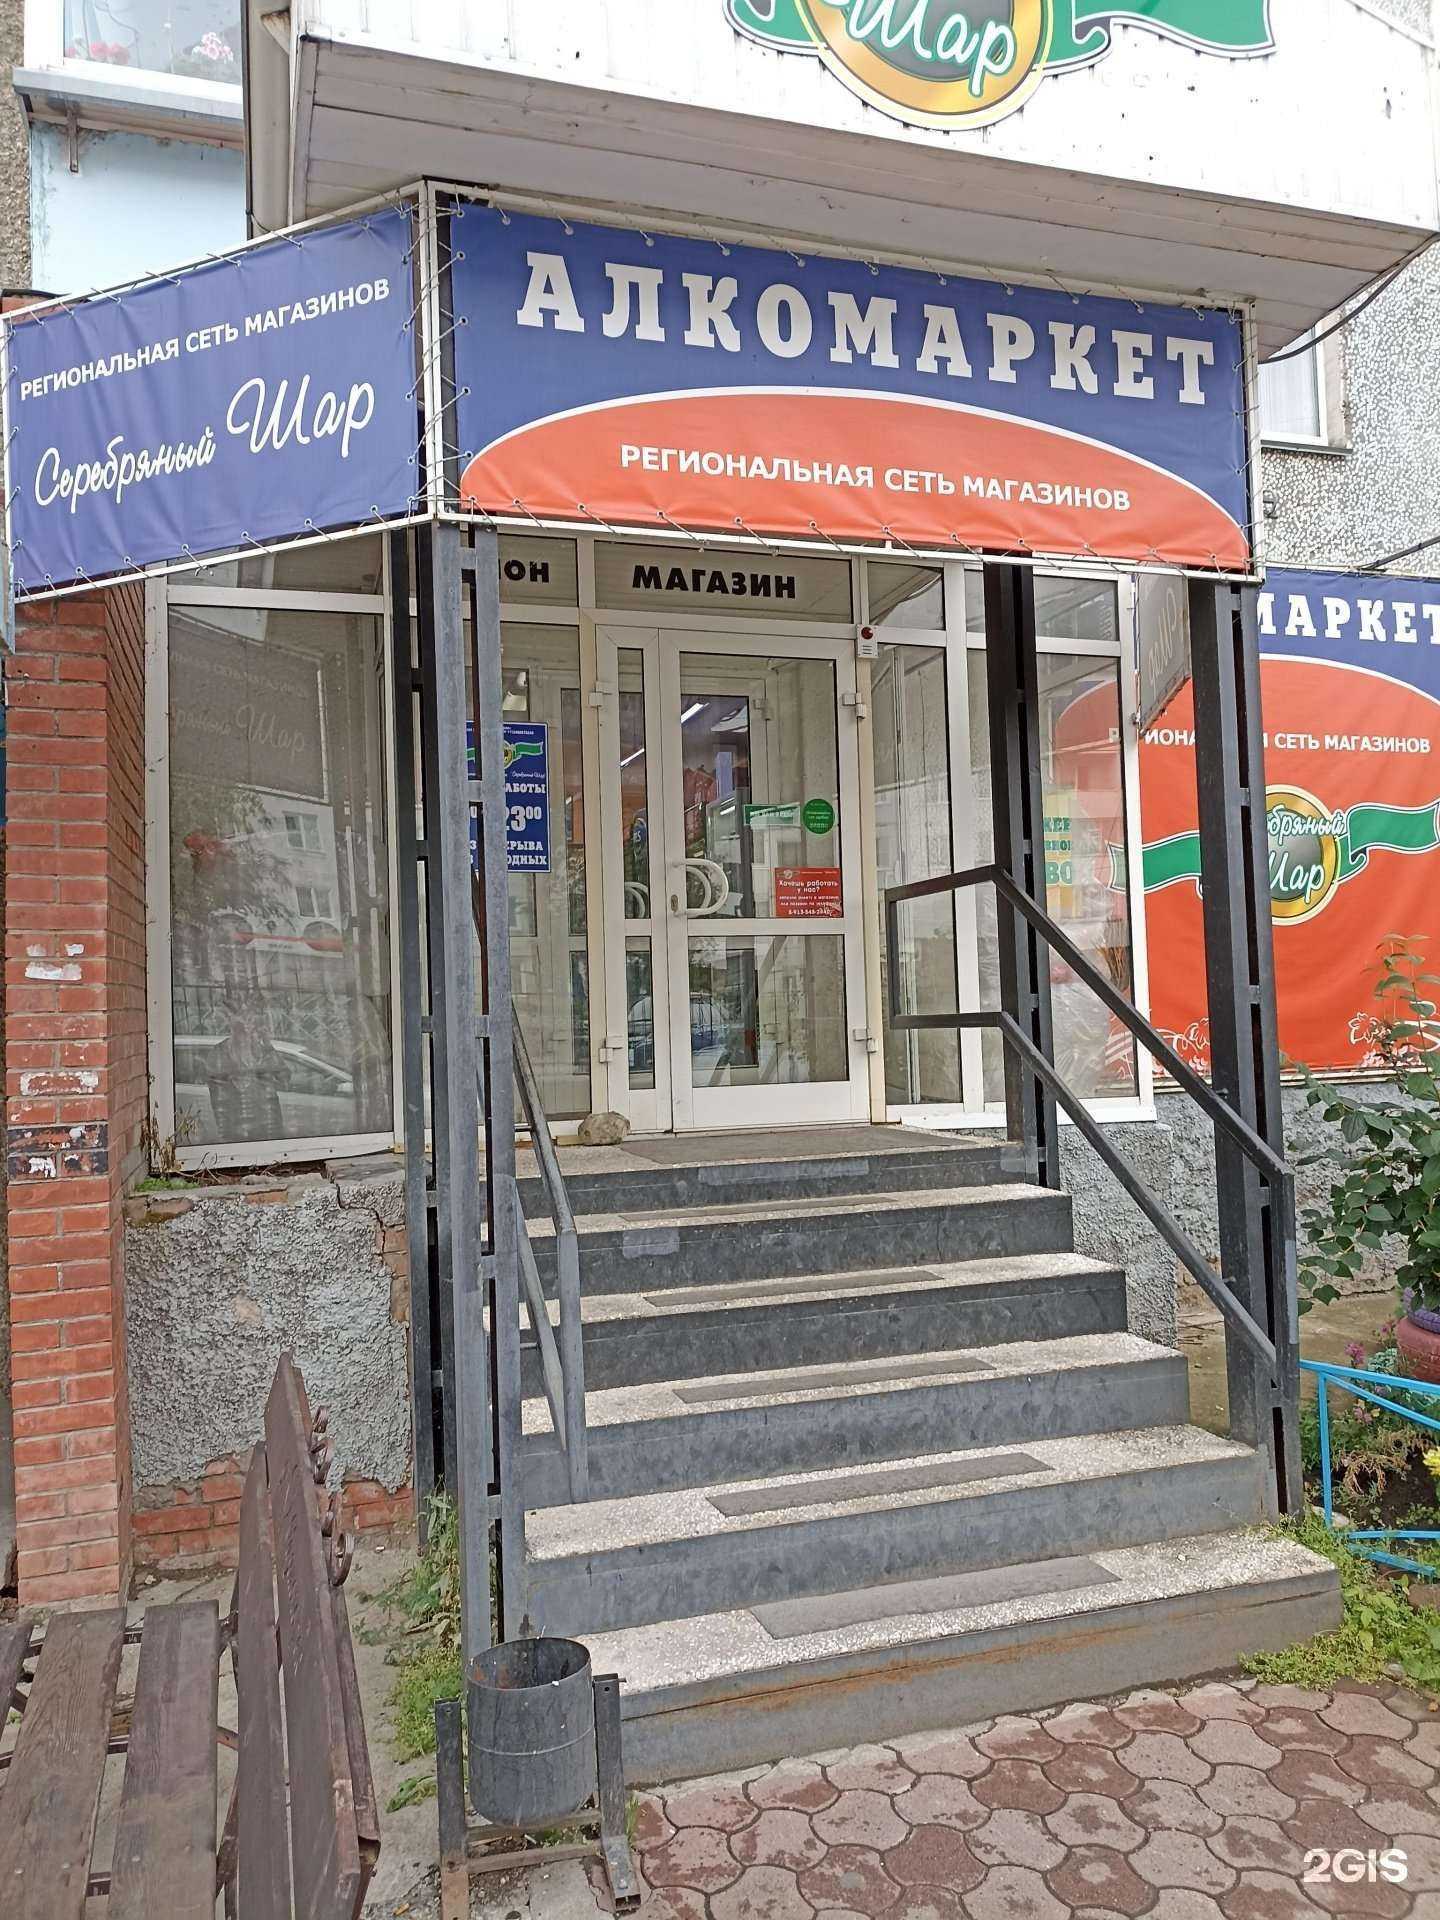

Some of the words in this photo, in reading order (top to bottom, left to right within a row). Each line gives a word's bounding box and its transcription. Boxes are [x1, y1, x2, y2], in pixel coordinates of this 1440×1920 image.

[20, 338, 179, 401] РЕГИОНАЛЬНАЯ
[185, 324, 239, 352] СЕТЬ
[244, 278, 390, 336] МАГАЗИНОВ
[516, 251, 1215, 405] АЛКОМАРКЕТ
[34, 426, 217, 513] Серебряный
[226, 374, 376, 457] Шар
[620, 444, 875, 489] РЕГИОНАЛЬНАЯ
[885, 466, 955, 497] СЕТЬ
[963, 474, 1131, 512] МАГАЗИНОВ
[499, 559, 550, 583] ОН
[632, 565, 796, 598] МАГАЗИН
[1275, 733, 1320, 750] СЕТЬ
[1325, 735, 1430, 753] МАГАЗИНОВ
[505, 783, 546, 794] АБОТЫ
[1267, 804, 1344, 845] бряный
[507, 855, 547, 866] ОДНЫХ
[508, 840, 544, 851] РЫВА
